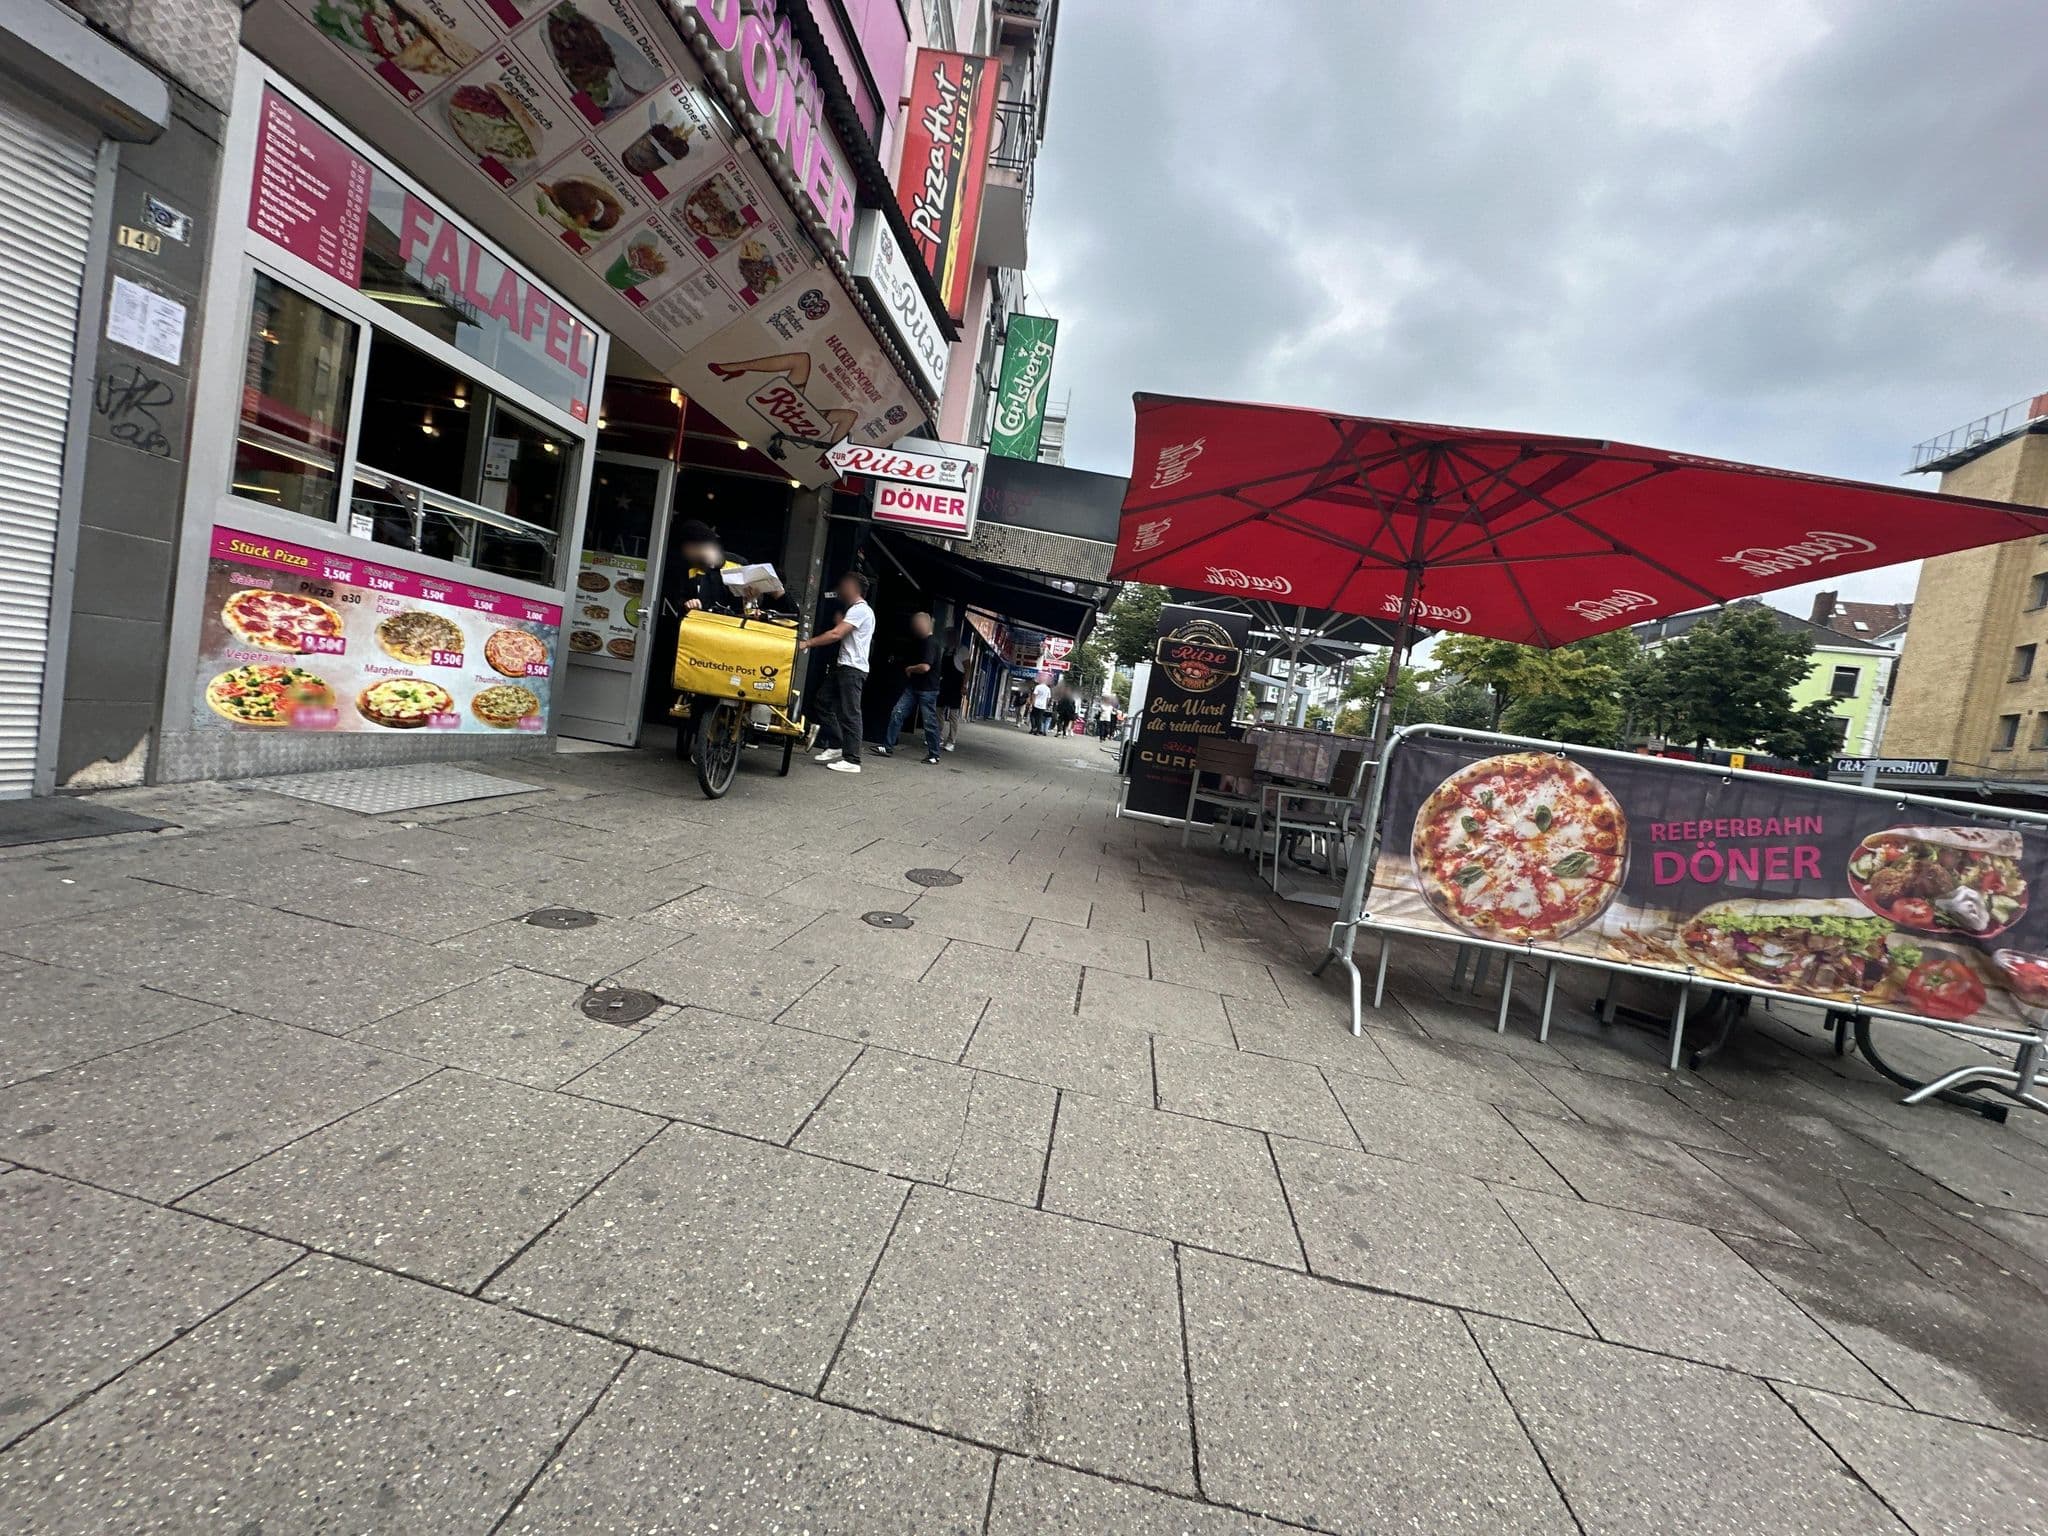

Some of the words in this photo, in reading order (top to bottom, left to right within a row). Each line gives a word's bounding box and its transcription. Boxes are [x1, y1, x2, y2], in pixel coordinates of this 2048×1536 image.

[637, 36, 663, 69] Döner
[507, 65, 539, 98] Döner
[500, 73, 552, 130] Vegetarisch
[923, 62, 958, 144] Hut
[953, 63, 973, 161] EXPRESS
[678, 96, 701, 124] Döner
[698, 124, 712, 141] Box
[591, 156, 616, 183] Falafel
[615, 179, 639, 207] Tasche
[911, 147, 948, 244] Pizza
[400, 193, 588, 379] FALAFEL
[892, 282, 943, 380] Ritze
[994, 340, 1053, 437] Carlsberg
[832, 452, 847, 461] ZUR
[834, 448, 936, 479] Ritze
[881, 488, 965, 516] DÖNER
[229, 539, 270, 559] Stück
[274, 550, 309, 566] Pizza
[323, 566, 352, 582] 3,50€
[368, 577, 394, 590] 3,50€
[421, 588, 445, 600] 3,50€
[306, 634, 344, 652] 9,50€
[433, 652, 463, 665] 9,50€
[1171, 645, 1226, 663] Ritze
[364, 664, 414, 677] Margherita
[527, 664, 549, 676] 9,50€
[689, 657, 734, 673] Deutsche
[736, 665, 756, 676] Post
[1150, 697, 1179, 713] Eine
[1182, 699, 1226, 715] Wurst
[1147, 718, 1166, 731] die
[1650, 814, 1823, 844] REEPERBAHN
[1653, 841, 1823, 887] DÖNER
